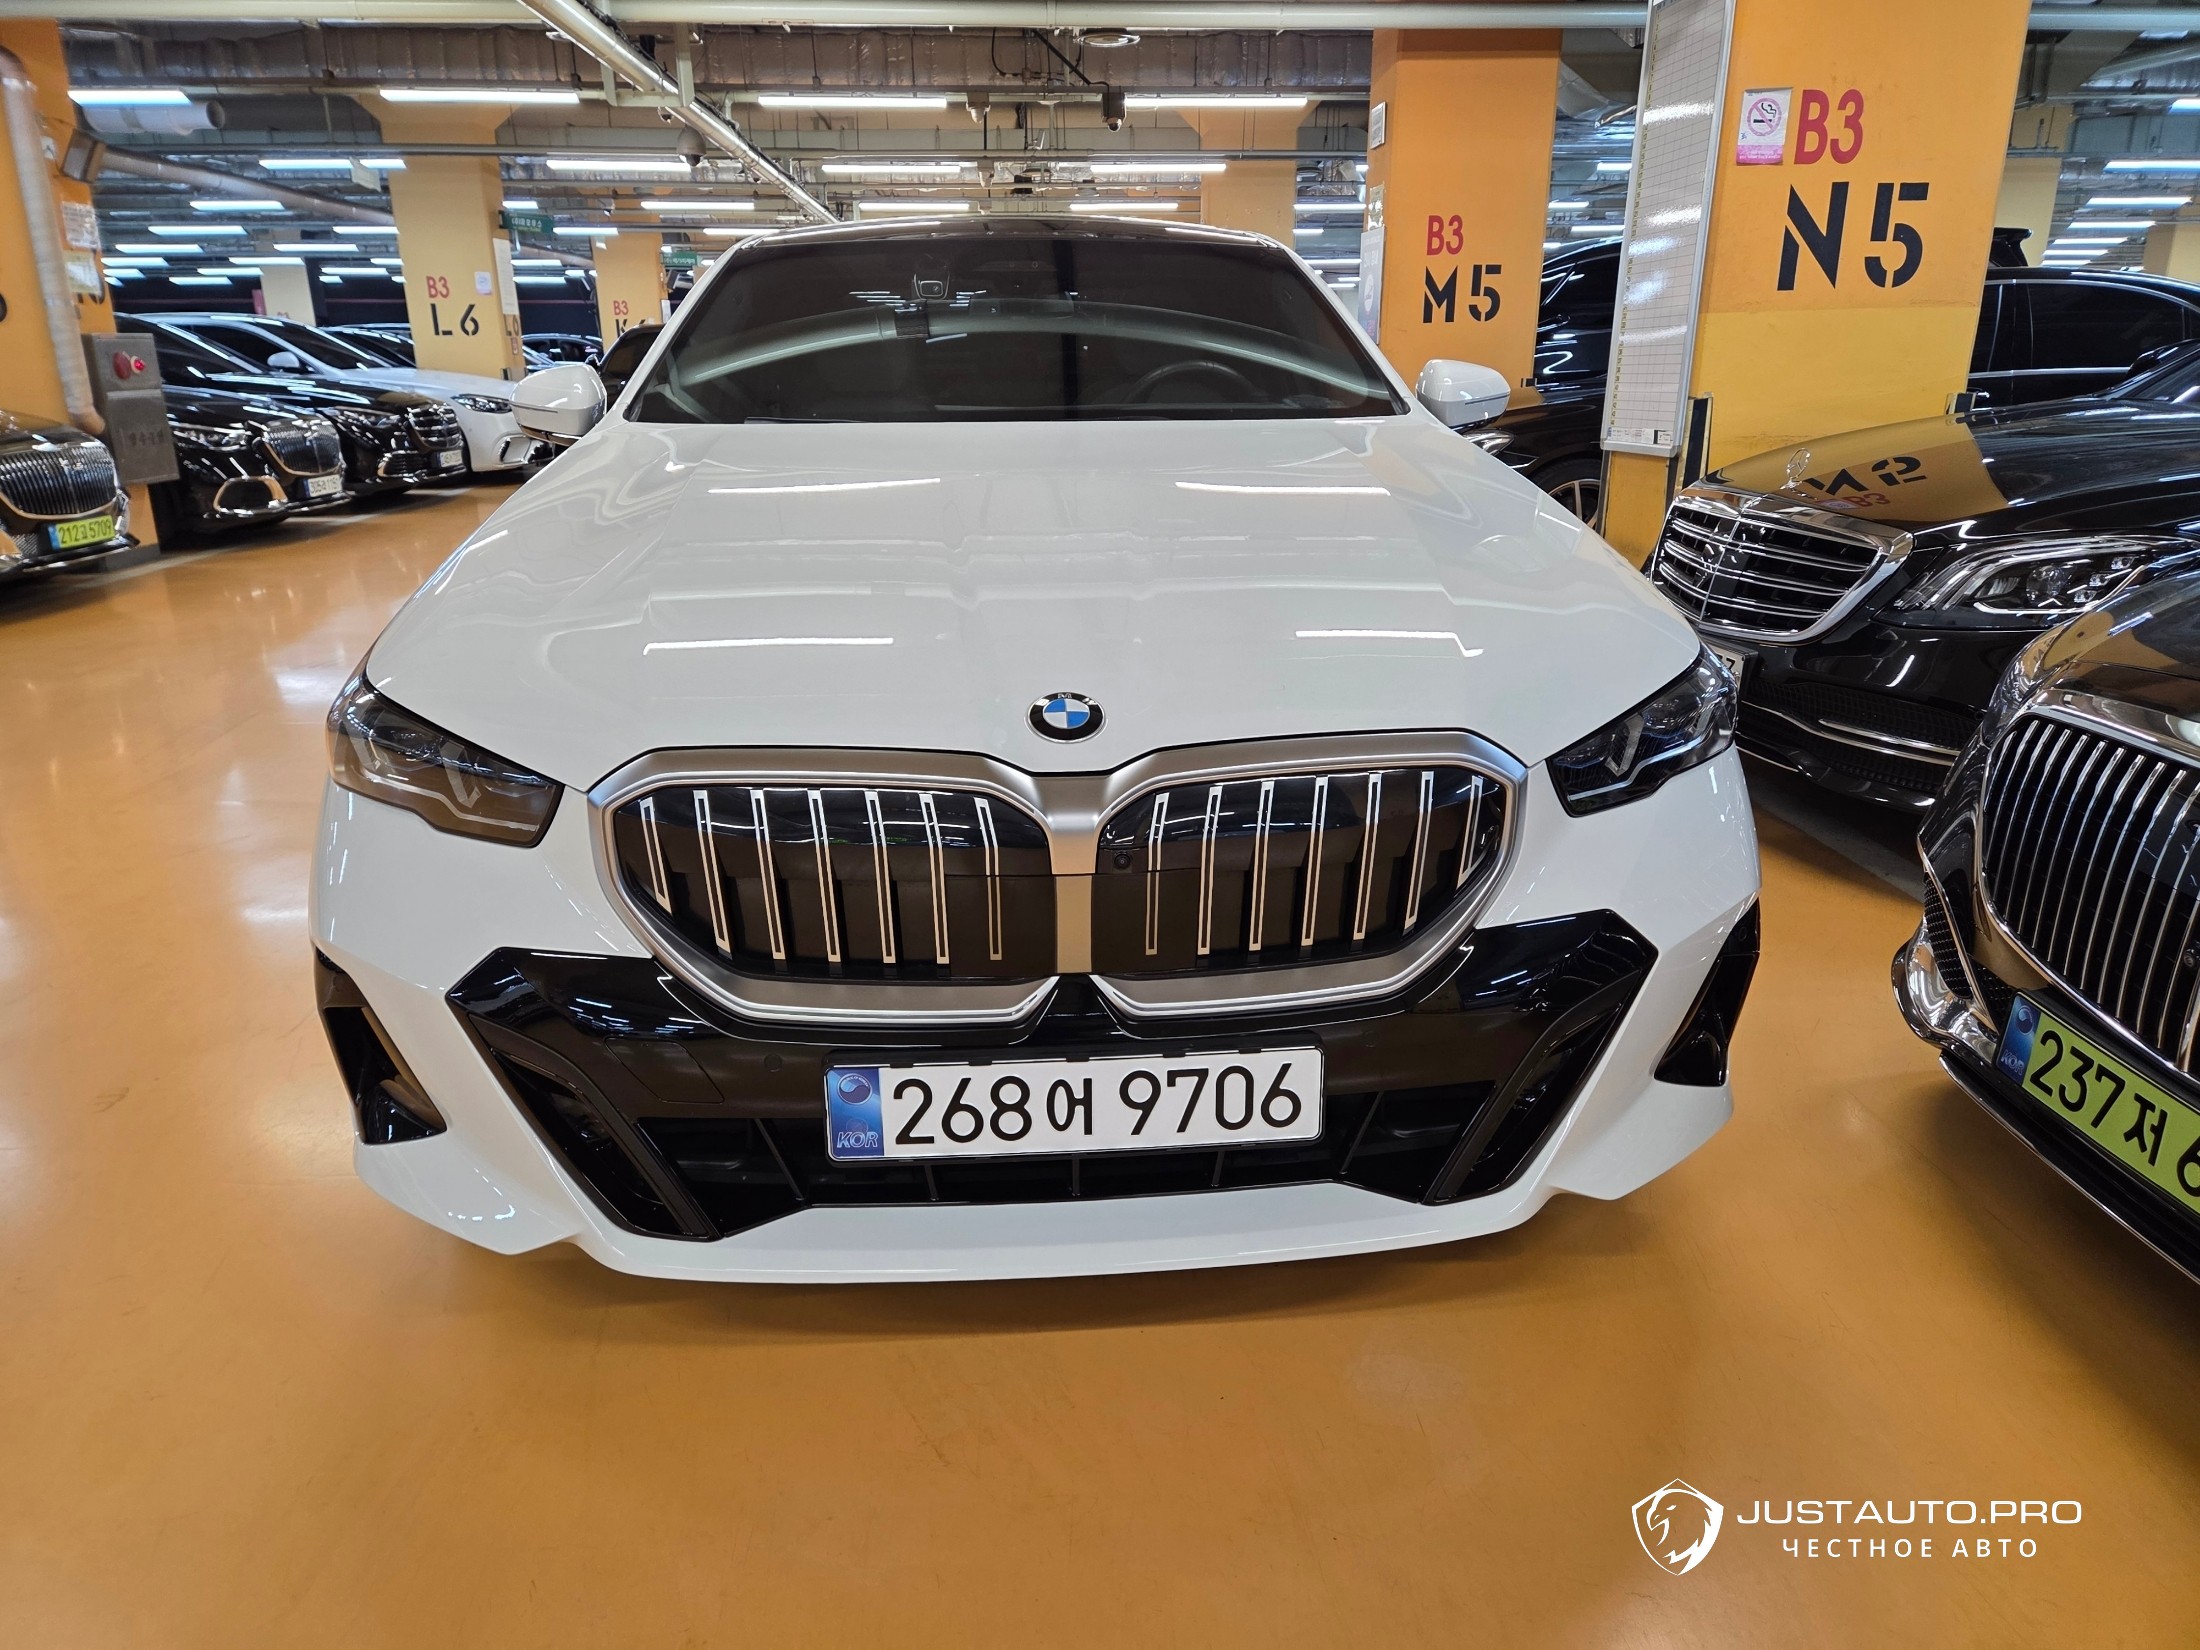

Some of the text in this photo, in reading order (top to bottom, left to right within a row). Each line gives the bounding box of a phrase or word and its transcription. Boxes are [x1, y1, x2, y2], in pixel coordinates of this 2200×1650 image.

[1794, 89, 1864, 164] B3
[1427, 214, 1464, 256] B3
[426, 276, 450, 299] B3
[613, 300, 629, 315] B3
[2001, 1050, 2024, 1076] KOR
[1119, 1063, 1302, 1136] 9706
[837, 1131, 878, 1148] KOR
